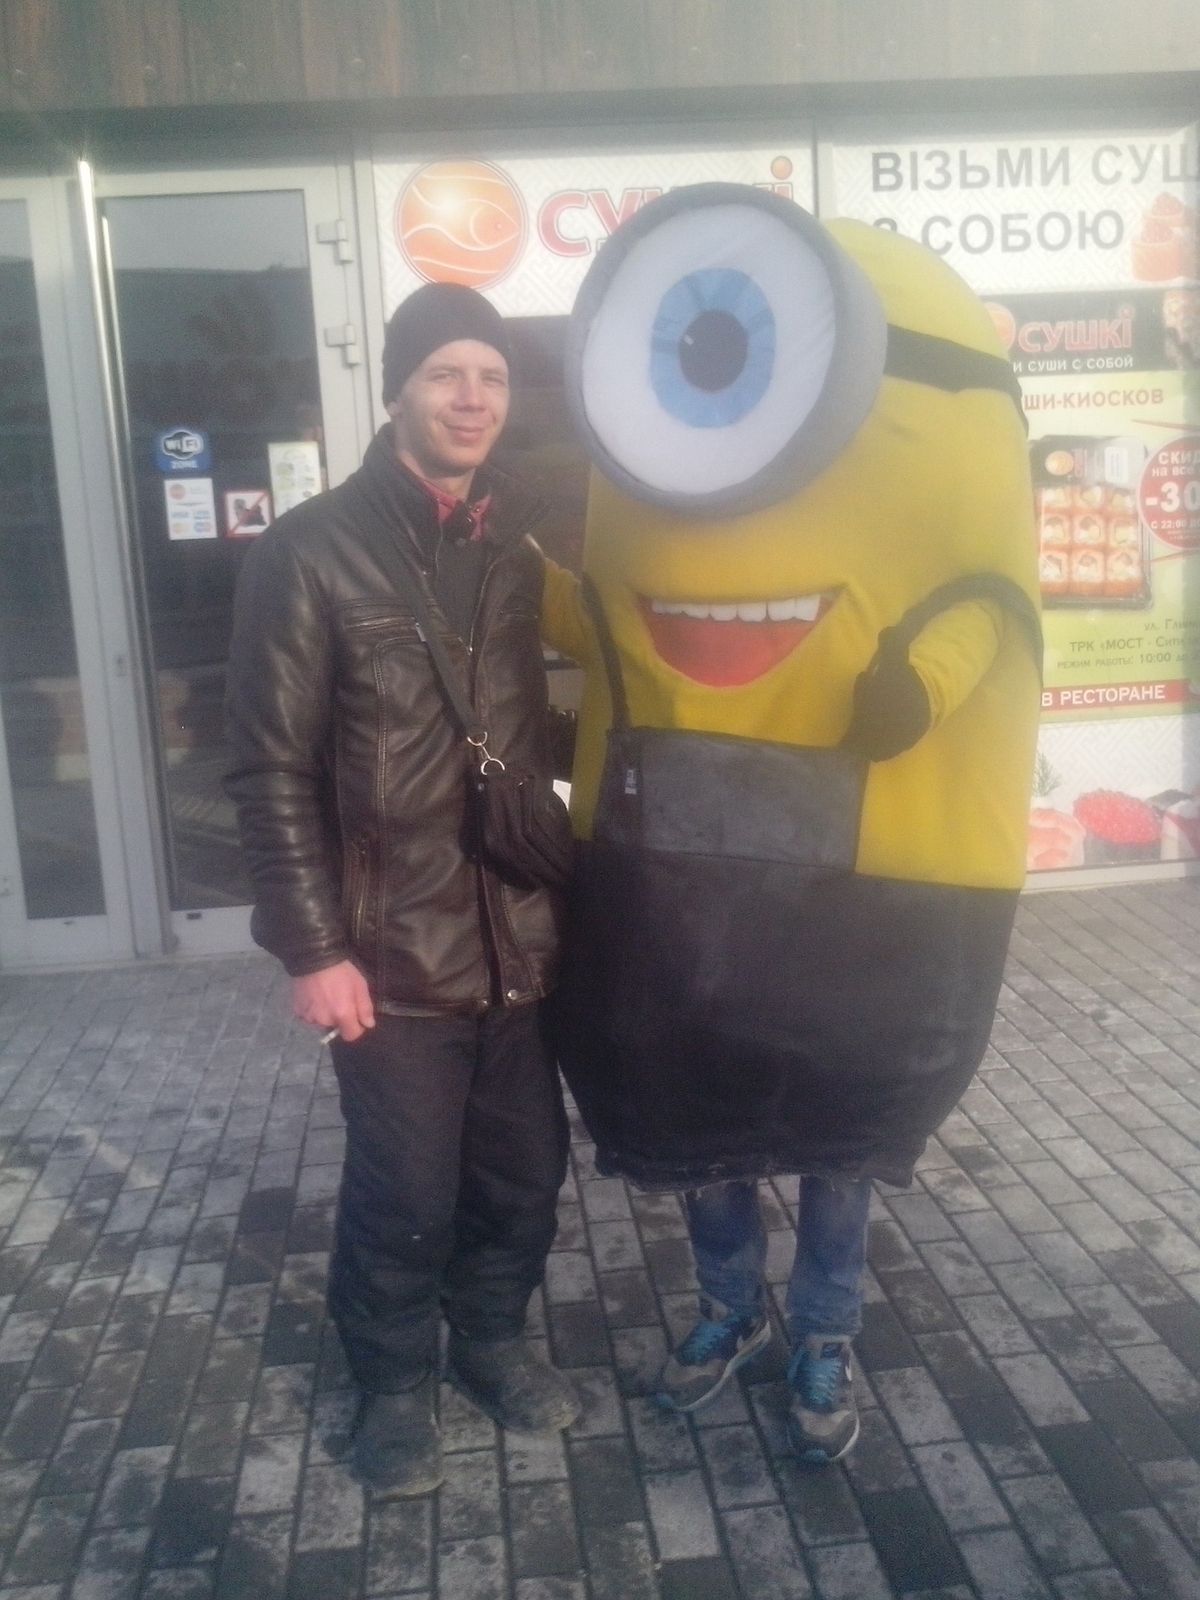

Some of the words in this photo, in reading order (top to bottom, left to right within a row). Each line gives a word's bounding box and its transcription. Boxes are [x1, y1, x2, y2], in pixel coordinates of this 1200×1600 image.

[871, 146, 1071, 192] ВІЗЬМИ
[921, 209, 1125, 256] СОБОЮ
[1028, 359, 1067, 372] СУШИ
[1072, 359, 1082, 370] С
[1086, 354, 1134, 370] СОБОЙ
[1158, 450, 1200, 465] СКИ
[1069, 640, 1095, 652] ТРК
[1139, 652, 1172, 664] 10:00
[1041, 692, 1053, 707] В
[1060, 684, 1166, 706] РЕСТОРАНЕ
